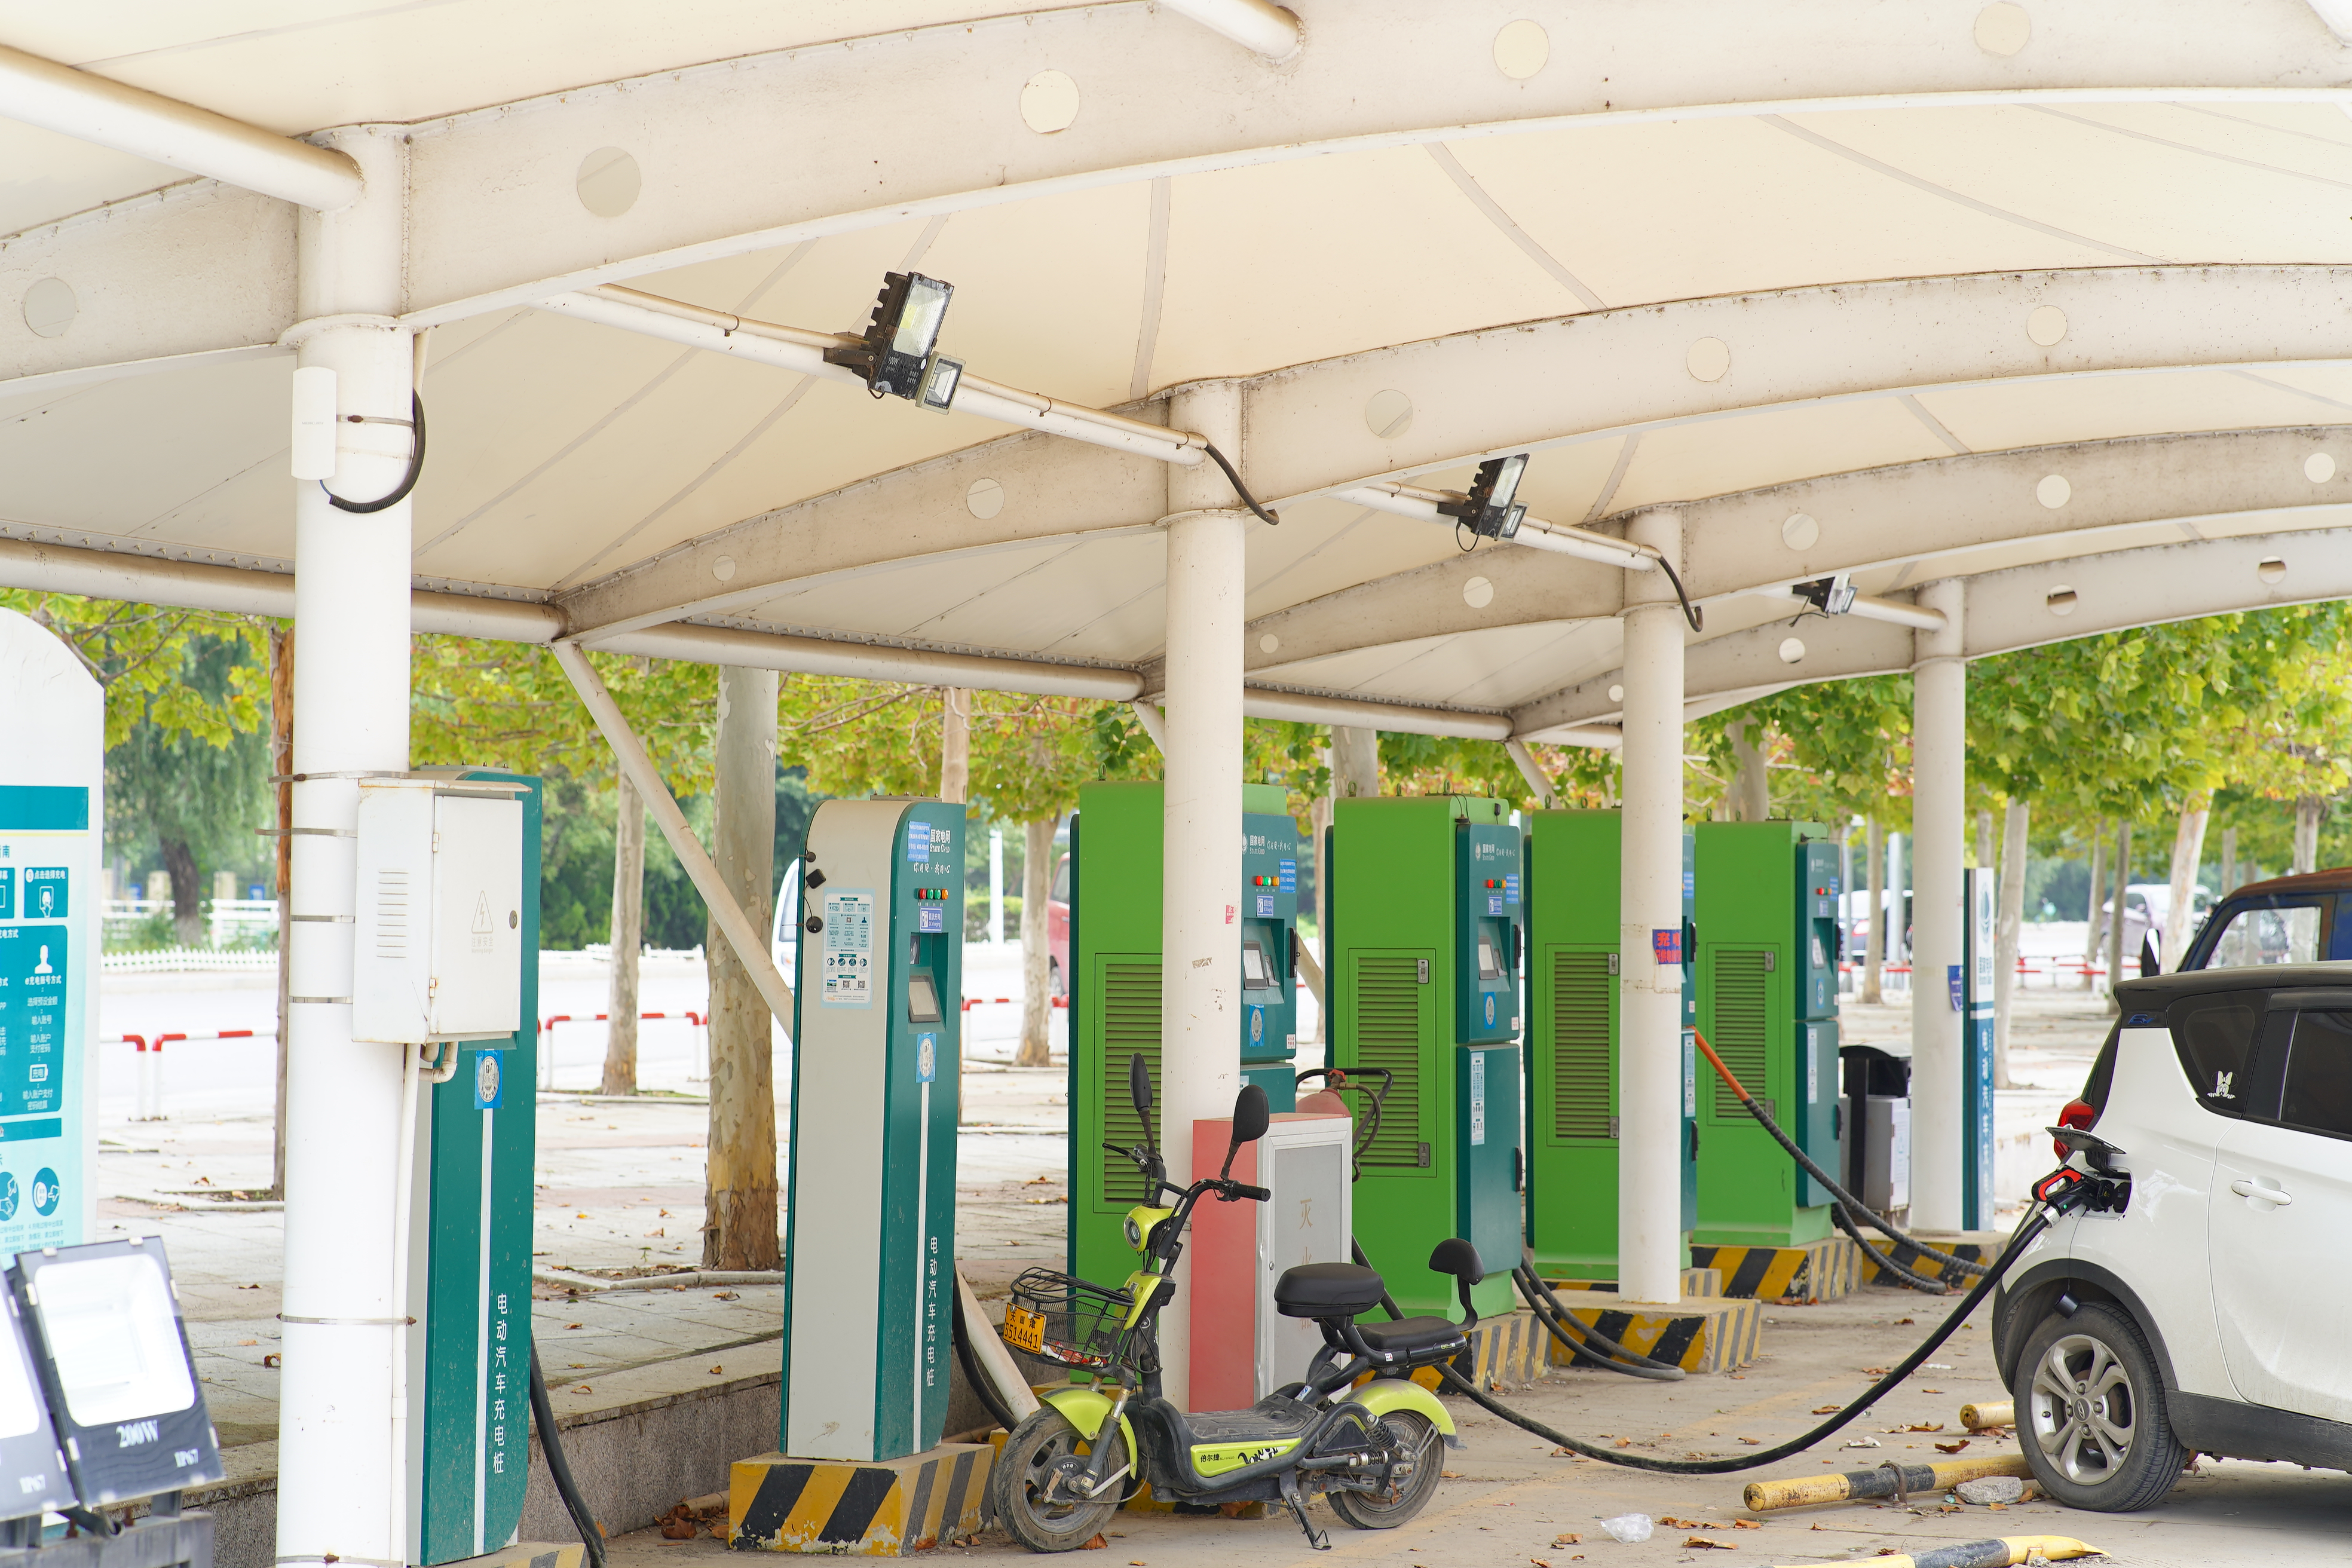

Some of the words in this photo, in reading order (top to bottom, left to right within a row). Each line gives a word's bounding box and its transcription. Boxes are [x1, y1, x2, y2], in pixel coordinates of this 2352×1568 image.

[930, 829, 951, 844] 国家电网
[1250, 835, 1265, 847] 国家电网
[0, 845, 10, 858] 南
[929, 843, 941, 853] STATE
[471, 936, 493, 947] 注意安全
[926, 1236, 938, 1387] 电动汽车充电桩
[1004, 1322, 1039, 1349] 5514441
[493, 1293, 508, 1475] 电动汽车充电桩
[116, 1420, 160, 1448] 200W
[174, 1448, 199, 1468] IP67
[1200, 1453, 1220, 1463] 倍尔捷
[19, 1474, 47, 1494] IP67
